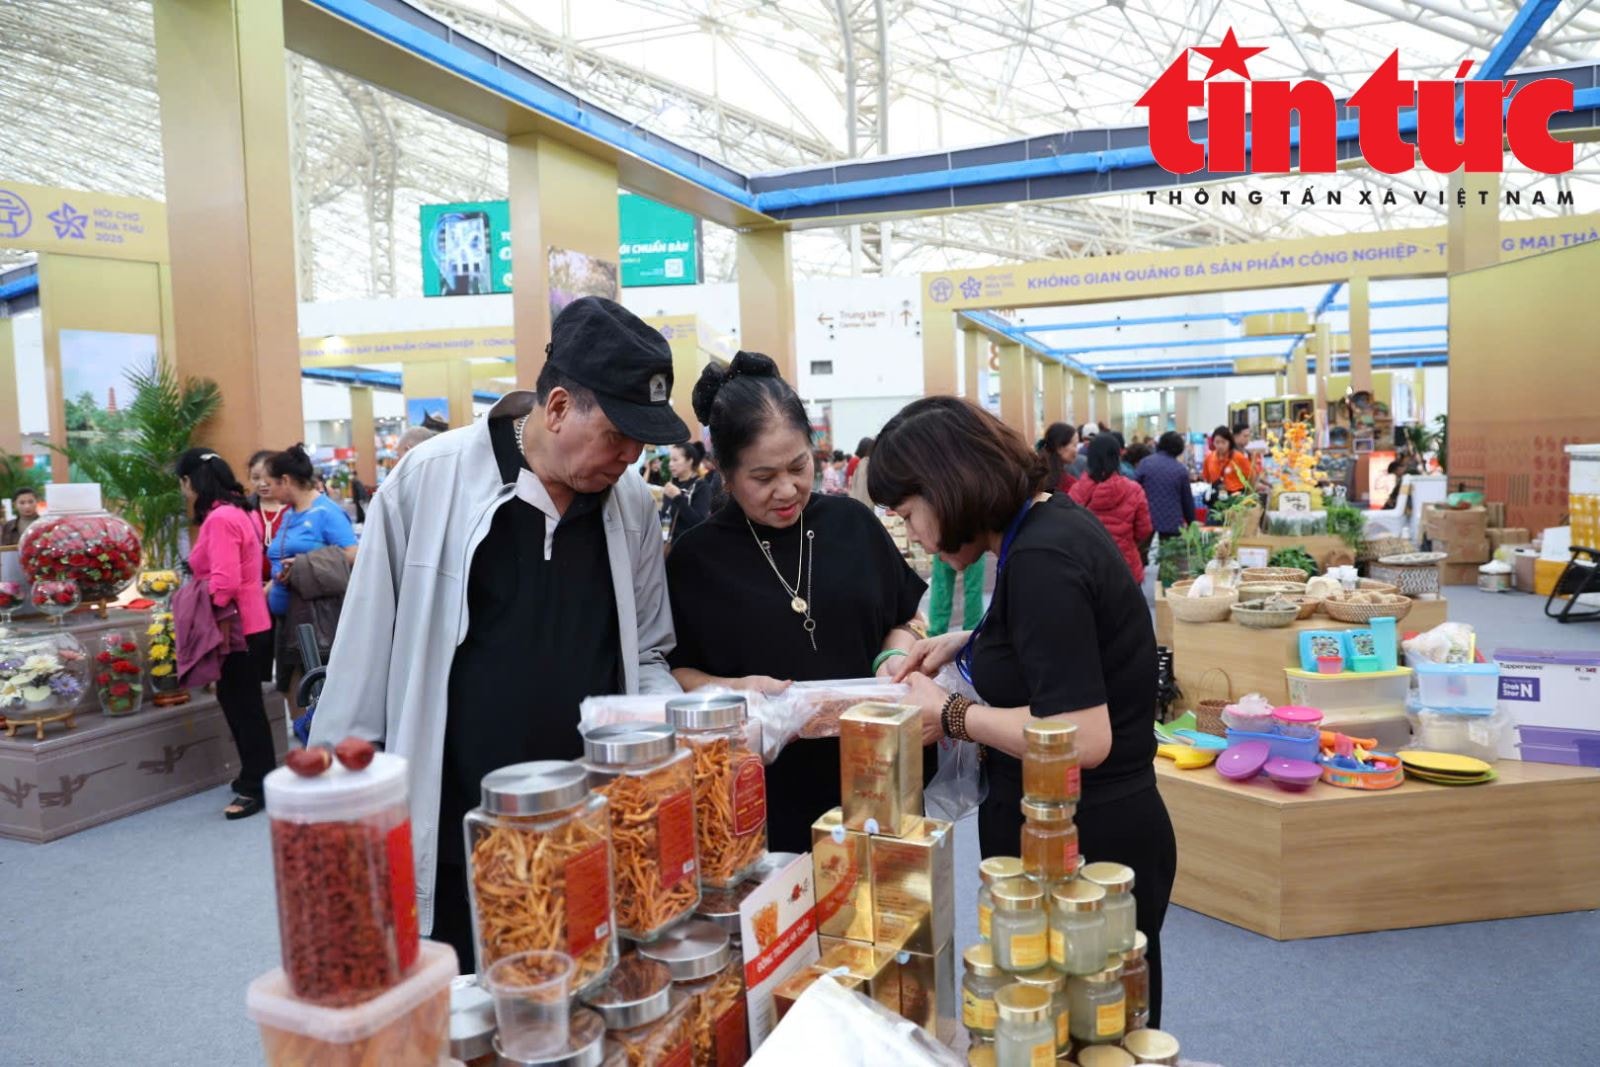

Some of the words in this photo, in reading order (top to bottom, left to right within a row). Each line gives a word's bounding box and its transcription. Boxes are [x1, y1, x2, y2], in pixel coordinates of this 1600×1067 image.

[1027, 272, 1081, 289] KHÔNG
[1084, 269, 1121, 285] GIAN
[1210, 258, 1243, 275] SẢN
[1246, 250, 1295, 272] PHẨM
[1297, 250, 1349, 267] CÔNG
[1352, 242, 1418, 262] NGHIỆP
